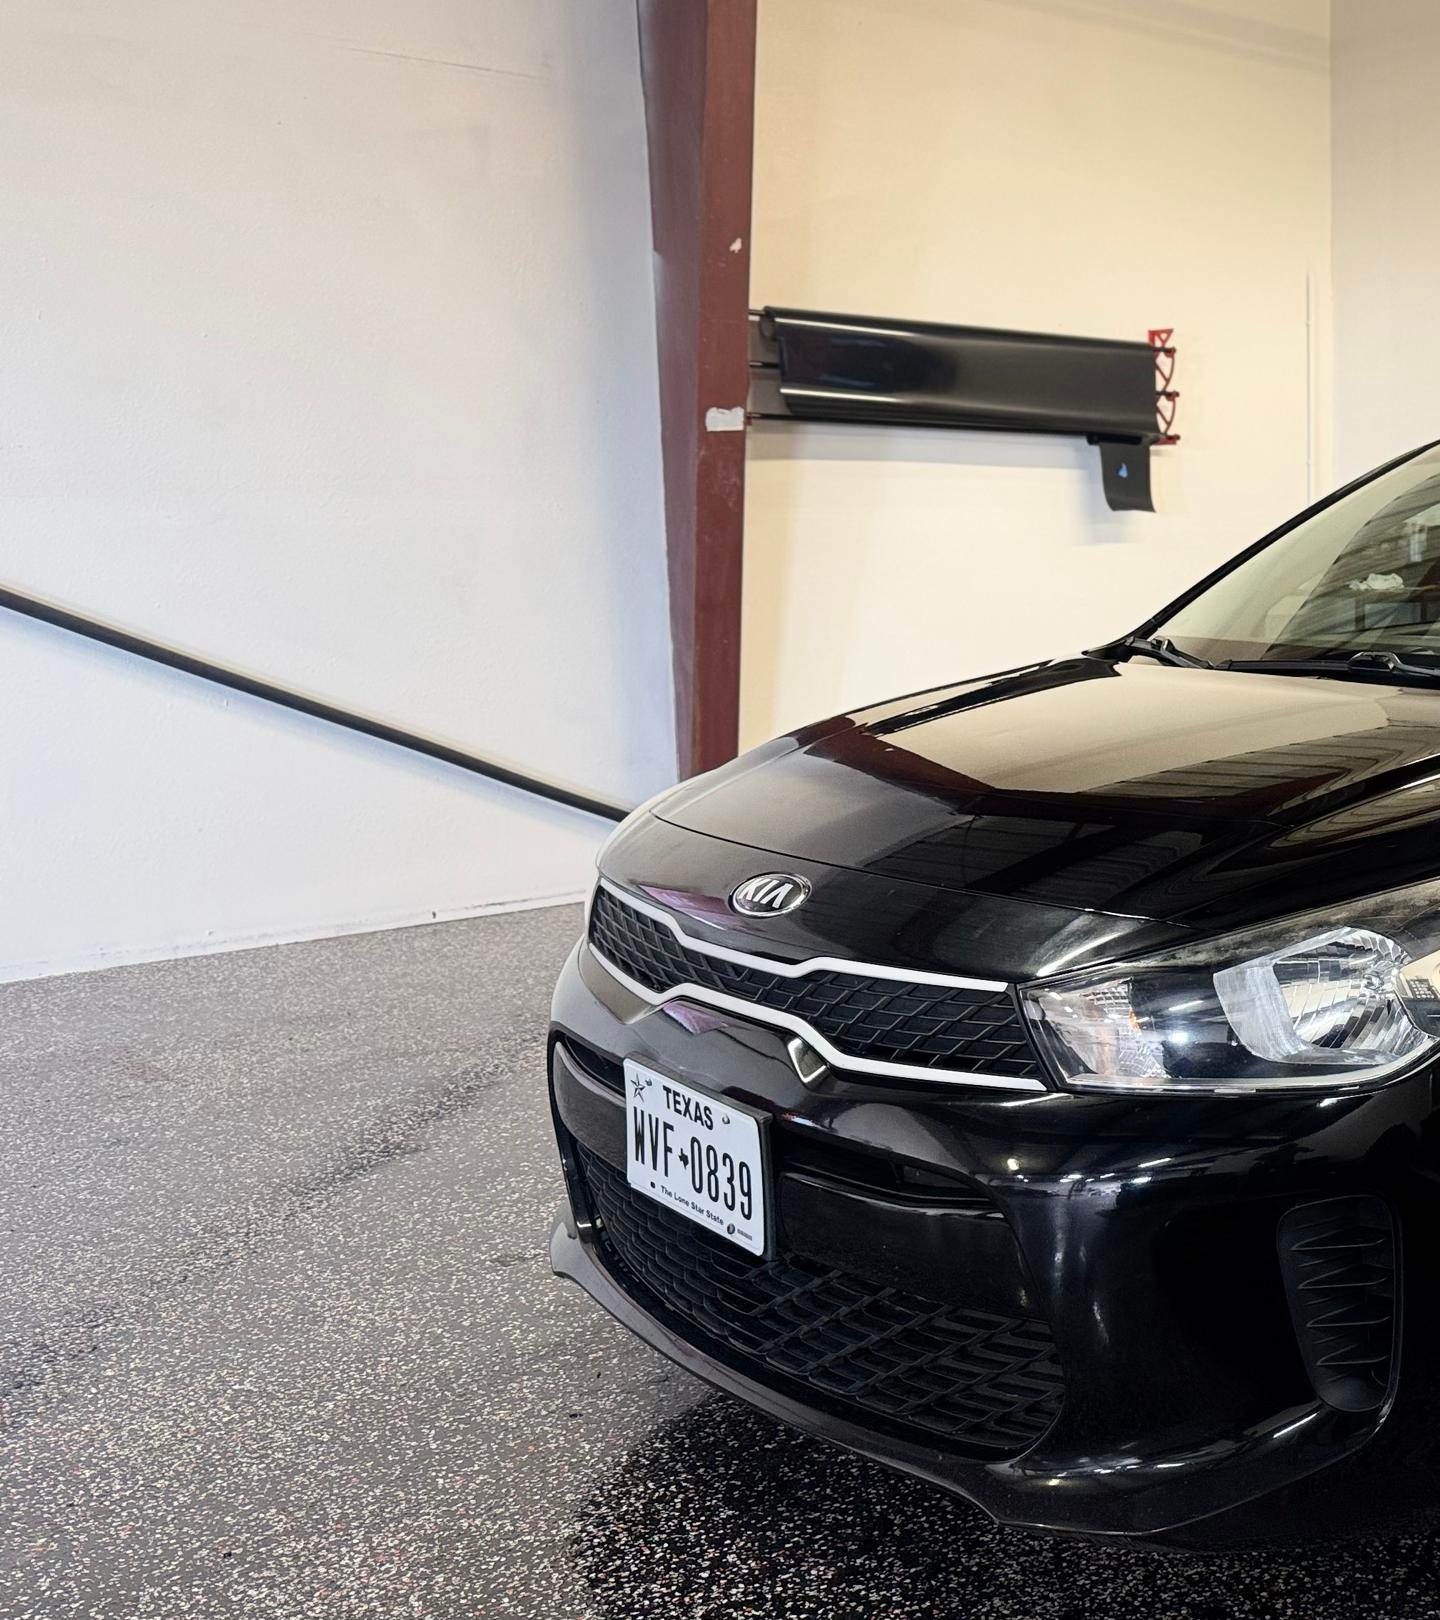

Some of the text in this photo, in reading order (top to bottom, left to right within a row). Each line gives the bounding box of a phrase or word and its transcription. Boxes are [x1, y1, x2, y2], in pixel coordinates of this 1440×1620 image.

[737, 878, 794, 909] KIA
[662, 1085, 714, 1131] TEXAS
[660, 1184, 724, 1226] The Lone Star State
